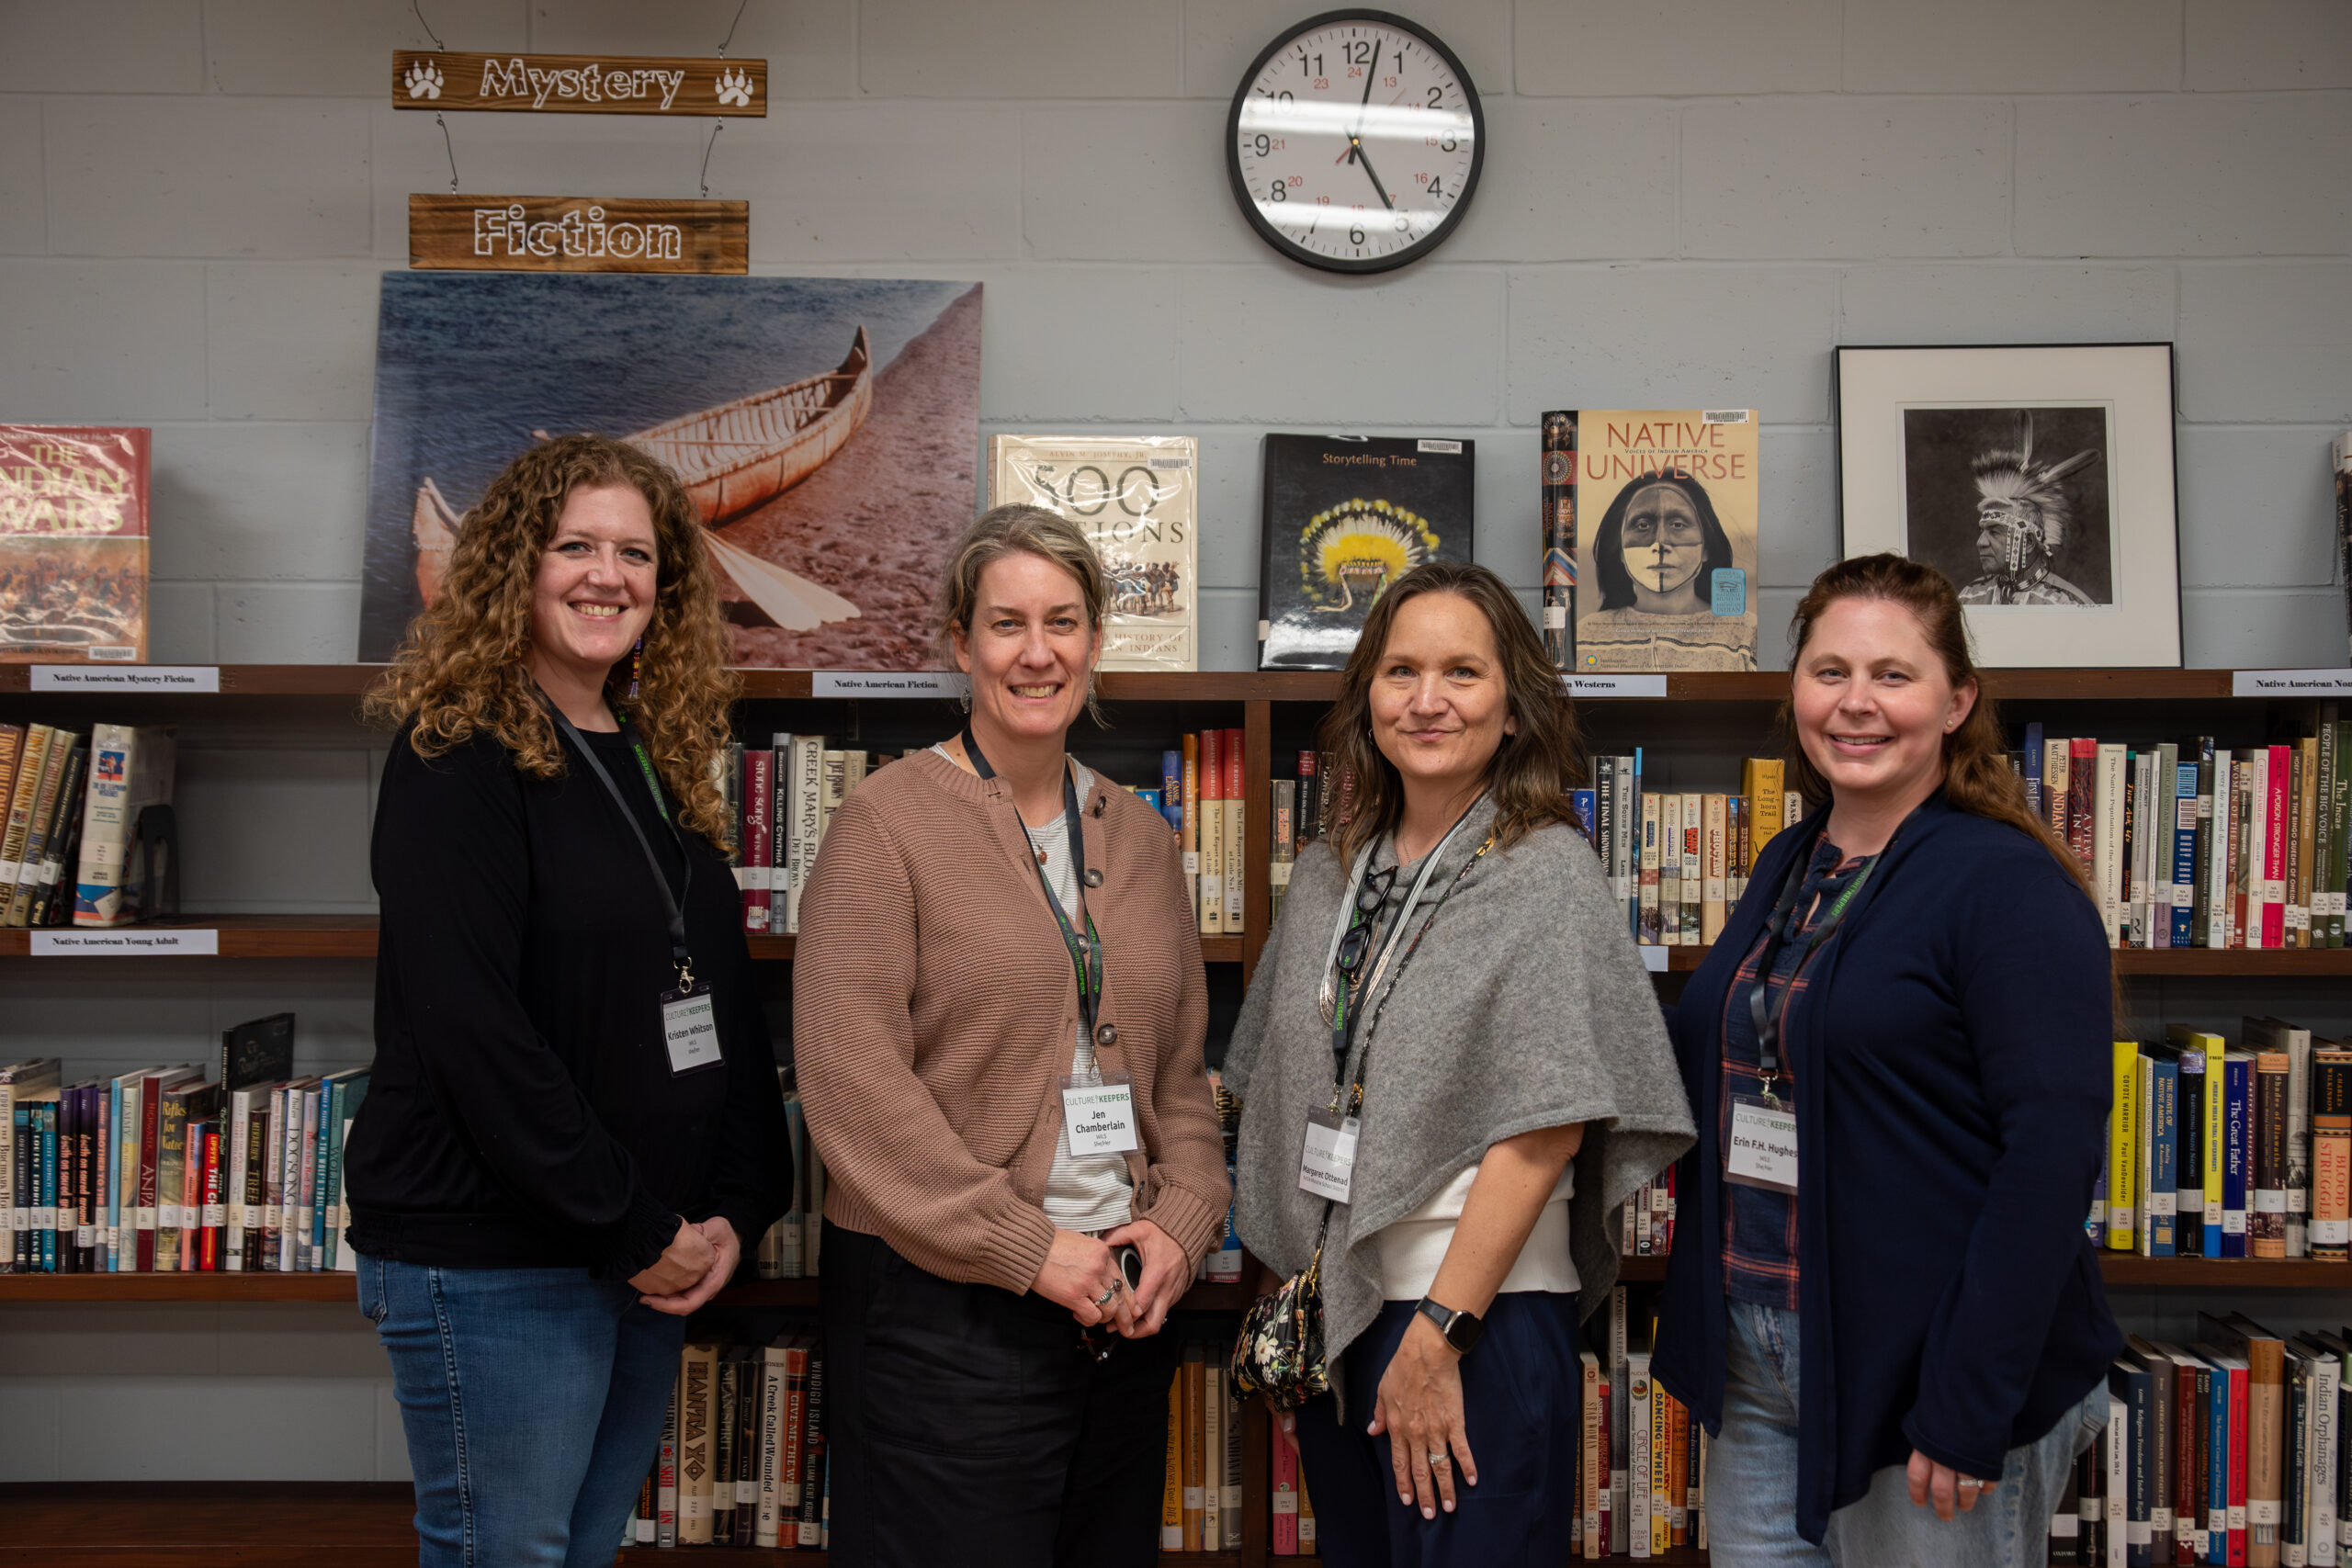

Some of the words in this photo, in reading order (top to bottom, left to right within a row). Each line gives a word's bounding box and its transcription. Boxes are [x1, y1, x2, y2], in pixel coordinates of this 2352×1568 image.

[1341, 40, 1370, 64] 12
[1393, 51, 1403, 73] 1
[1299, 53, 1323, 76] 11
[1347, 67, 1362, 78] 24
[480, 59, 685, 109] Mystery
[1314, 78, 1329, 90] 23
[1384, 77, 1397, 87] 13
[1428, 86, 1442, 109] 2
[1255, 134, 1270, 157] 9
[1272, 140, 1286, 150] 21
[1441, 129, 1457, 152] 3
[1288, 176, 1303, 186] 20
[1414, 173, 1428, 184] 16
[1427, 176, 1442, 198] 4
[1271, 180, 1286, 202] 8
[1316, 197, 1329, 207] 19
[474, 204, 681, 258] Fiction
[1350, 222, 1365, 245] 6
[1607, 423, 1724, 448] NATIVE
[29, 445, 81, 465] THE
[1323, 453, 1386, 468] Storytelling
[1390, 456, 1418, 467] Time
[1587, 454, 1746, 479] UNIVERSE
[0, 467, 123, 494] NDIAN
[1077, 521, 1183, 543] TIONS
[1115, 634, 1163, 642] HISTORY
[1129, 644, 1177, 652] INDIANS
[53, 673, 81, 682] Native
[84, 674, 125, 683] American
[127, 674, 162, 685] Mystery
[164, 675, 195, 683] Fiction
[834, 680, 862, 688] Native
[908, 681, 938, 689] Fiction
[1575, 680, 1616, 689] Westerns
[2321, 724, 2332, 758] PEOPLE
[805, 741, 819, 786] CREEK
[2051, 743, 2059, 785] MATTHIESSEN
[2320, 759, 2331, 772] OF
[754, 761, 765, 797] stone
[1601, 780, 1610, 799] THE
[2319, 774, 2330, 793] THE
[2335, 779, 2347, 799] The
[775, 788, 785, 822] KILLING
[1621, 786, 1629, 804] THE
[2319, 795, 2329, 811] BIG
[746, 797, 767, 834] song
[802, 792, 819, 839] MARY'S
[1184, 802, 1193, 828] Sky
[1600, 800, 1610, 828] FINAL
[2052, 791, 2065, 829] INDIAN
[2273, 794, 2282, 820] POISON
[2334, 802, 2346, 829] Incas
[2272, 822, 2281, 858] STRONGER
[2317, 813, 2328, 844] VOICE
[775, 826, 784, 863] CYNTHIA
[791, 838, 801, 855] DEE
[1600, 829, 1610, 873] SHOWDOW
[1710, 829, 1721, 877] CHOCTAW
[791, 858, 801, 888] BROWN
[1237, 859, 1242, 868] on
[2271, 859, 2280, 879] THAN
[2290, 868, 2296, 877] OF
[83, 937, 124, 945] American
[125, 938, 153, 947] Young
[155, 937, 179, 945] Adult
[668, 1030, 689, 1041] Kristen
[689, 1023, 713, 1035] Whitson
[1099, 1093, 1129, 1102] KEEPERS
[2325, 1067, 2334, 1112] WILKINSON
[1091, 1111, 1105, 1119] Jen
[2165, 1115, 2173, 1126] OF
[2231, 1100, 2242, 1118] The
[1076, 1121, 1125, 1134] Chamberlain
[1770, 1121, 1796, 1132] KEEPER
[2230, 1120, 2241, 1145] Great
[96, 1129, 107, 1171] BROTHER
[209, 1136, 218, 1165] LIPSYTE
[1734, 1136, 1749, 1146] Erin
[1752, 1140, 1766, 1151] F.H.
[1769, 1143, 1798, 1157] Hughes
[285, 1128, 300, 1205] DOGSONG
[2229, 1147, 2240, 1176] Father
[96, 1174, 106, 1186] TO
[1303, 1165, 1323, 1179] Margaret
[1325, 1172, 1348, 1186] Ottenad
[2318, 1142, 2332, 1219] STRUGGLE
[2335, 1155, 2346, 1207] BLOOD
[96, 1188, 105, 1206] THE
[809, 1361, 822, 1404] WINDIGO
[2317, 1373, 2331, 1411] Indian
[685, 1361, 708, 1441] HANTA
[766, 1385, 778, 1413] Creek
[789, 1394, 799, 1421] GIVE
[1586, 1402, 1596, 1421] STAR
[1653, 1393, 1664, 1440] DANCING
[764, 1415, 777, 1445] Called
[788, 1424, 798, 1441] ME
[807, 1409, 821, 1444] ISLAND
[1586, 1424, 1596, 1450] WOMAN
[787, 1444, 797, 1466] THE
[1636, 1429, 1648, 1463] CIRCLE
[2314, 1413, 2331, 1485] Orphanages
[763, 1447, 776, 1492] Wounded
[806, 1453, 817, 1482] WILLIAM
[1636, 1465, 1648, 1480] OF
[1653, 1450, 1663, 1490] WHEEL
[804, 1483, 816, 1500] KENT
[1636, 1482, 1648, 1500] LIFE
[804, 1501, 816, 1523] KRUEG
